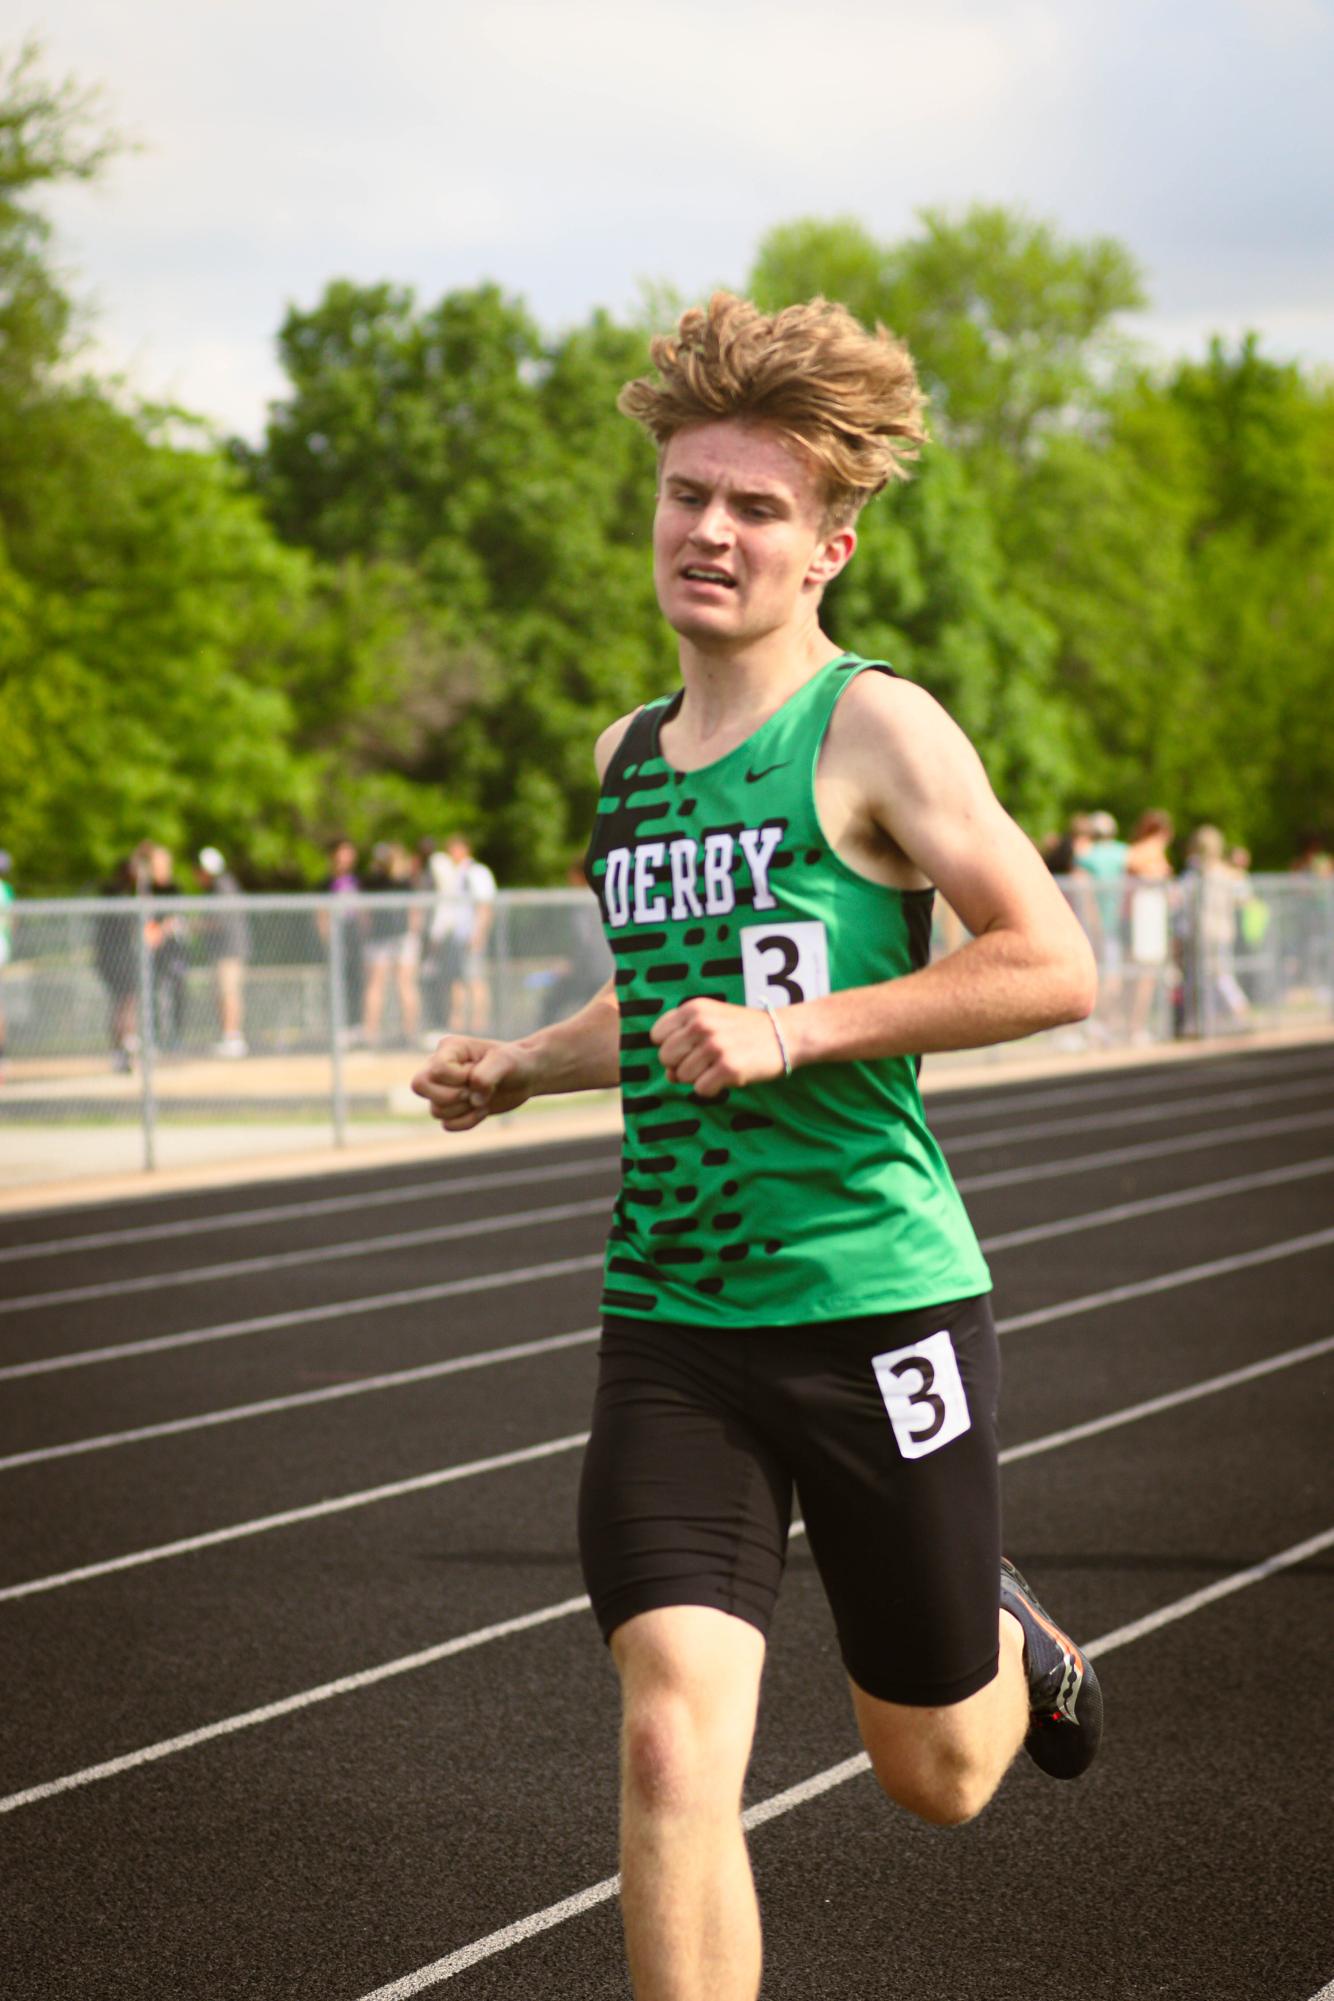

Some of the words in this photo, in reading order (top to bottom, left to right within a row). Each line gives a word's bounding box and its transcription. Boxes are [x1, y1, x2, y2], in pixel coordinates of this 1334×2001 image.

[604, 827, 783, 928] DERBY
[755, 935, 804, 1005] 3
[890, 1356, 946, 1443] 3
